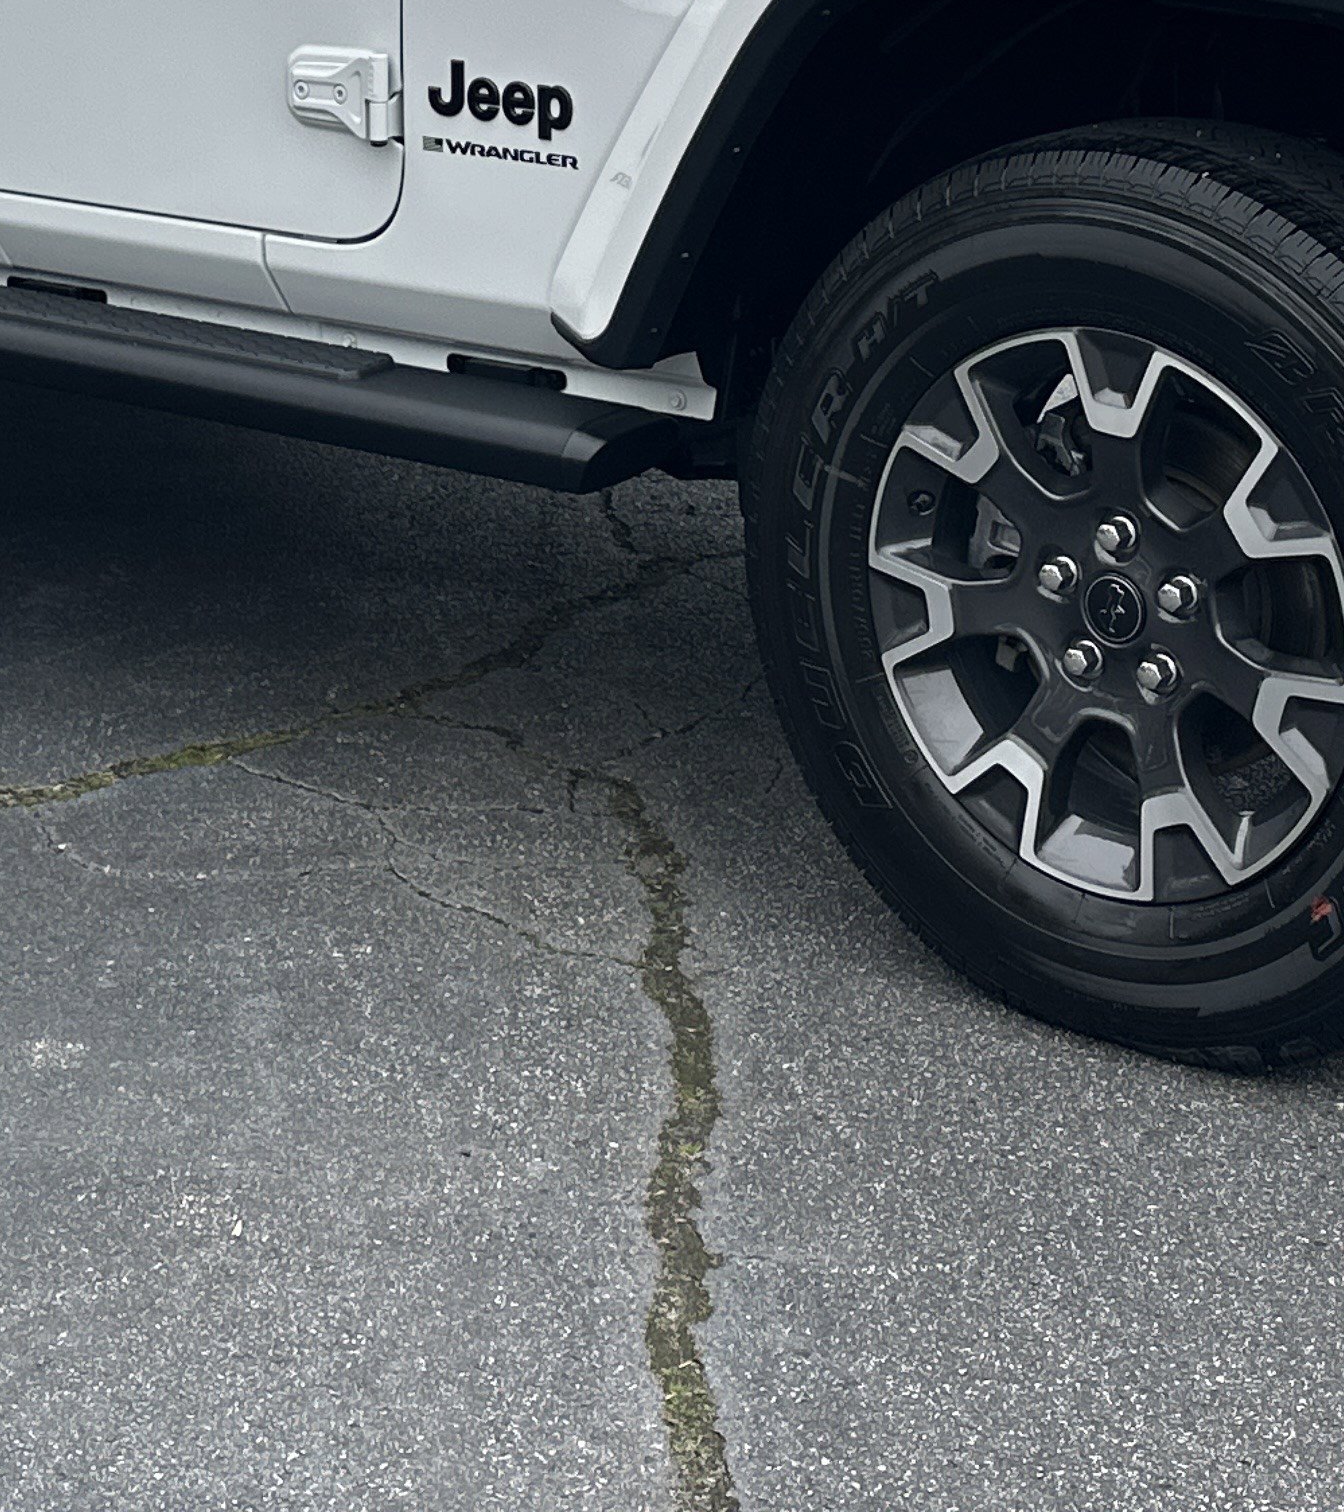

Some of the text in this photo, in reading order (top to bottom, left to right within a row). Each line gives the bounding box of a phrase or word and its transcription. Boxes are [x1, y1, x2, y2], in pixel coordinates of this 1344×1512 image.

[427, 59, 573, 141] Jeep
[445, 138, 579, 170] WRANGLER
[785, 269, 939, 809] DUELER H/T
